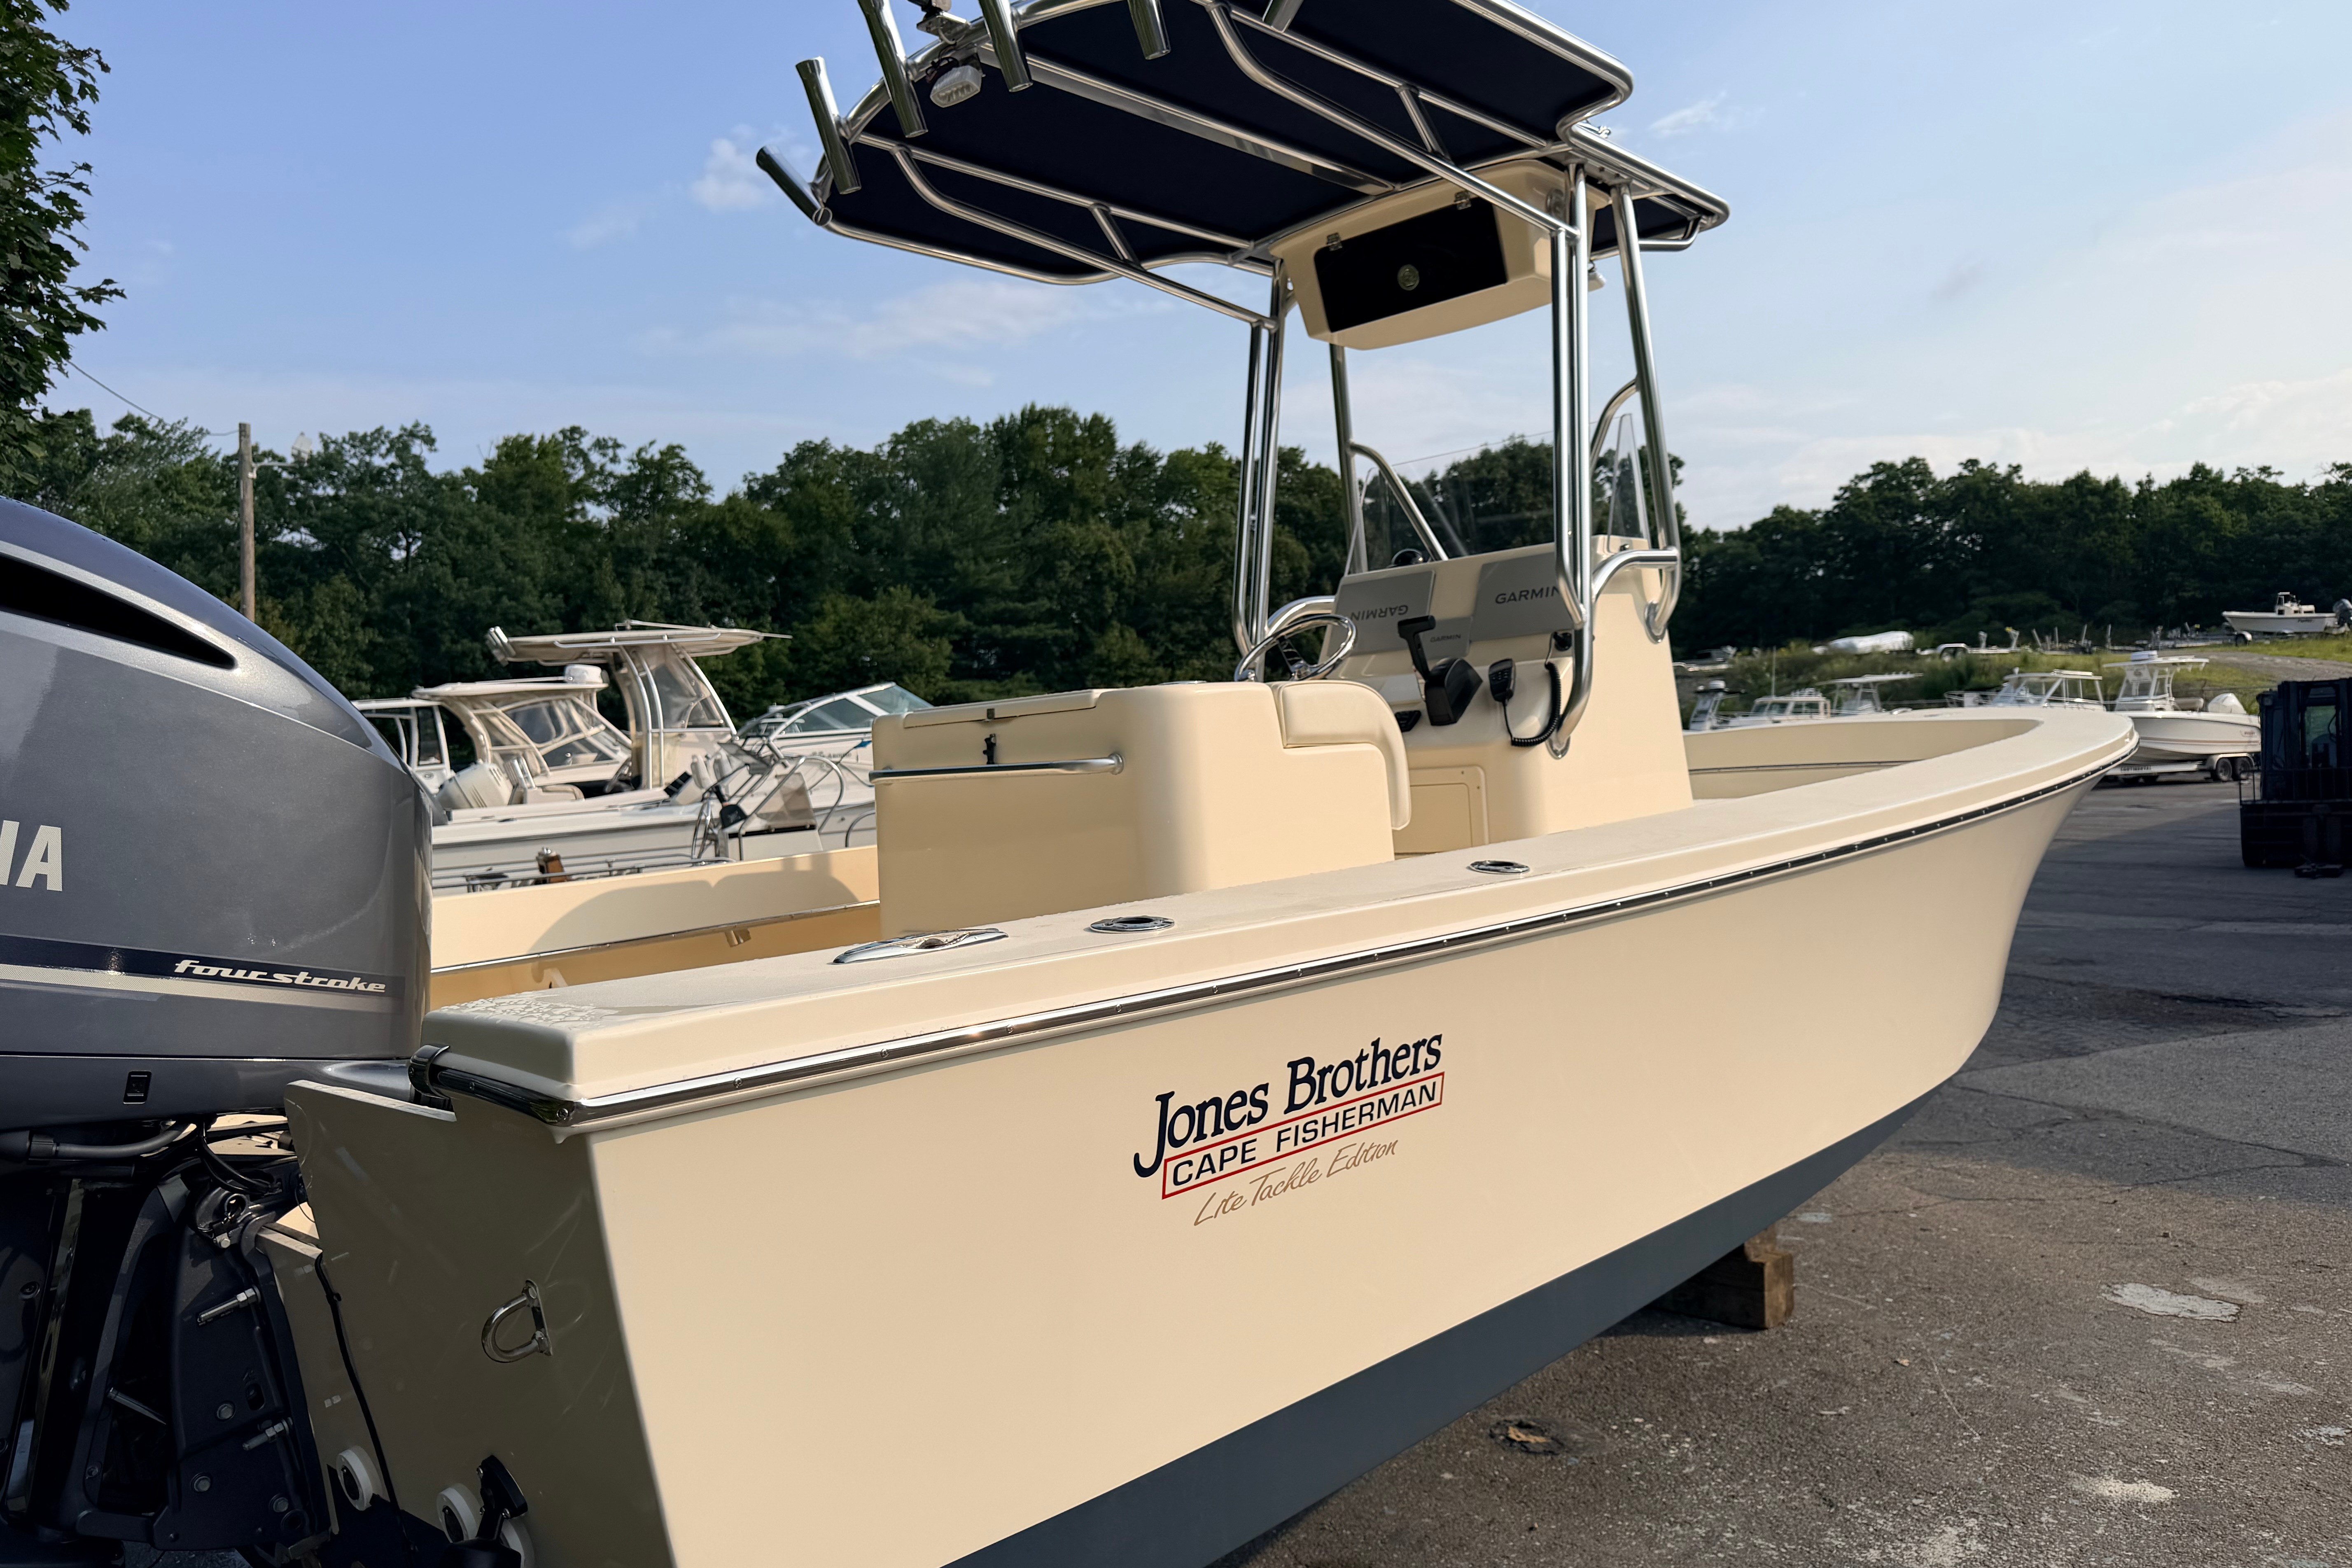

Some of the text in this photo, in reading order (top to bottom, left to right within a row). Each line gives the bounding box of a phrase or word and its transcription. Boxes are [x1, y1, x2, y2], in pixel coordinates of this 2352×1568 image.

[1351, 604, 1409, 621] GARMIN
[1495, 585, 1560, 604] GARMIN
[1429, 633, 1461, 643] GARMIN
[1134, 1034, 1442, 1178] Jones Brothers
[1173, 1081, 1436, 1186] CAPE FISHERMAN
[1193, 1139, 1399, 1227] Lite Tackle Edition
